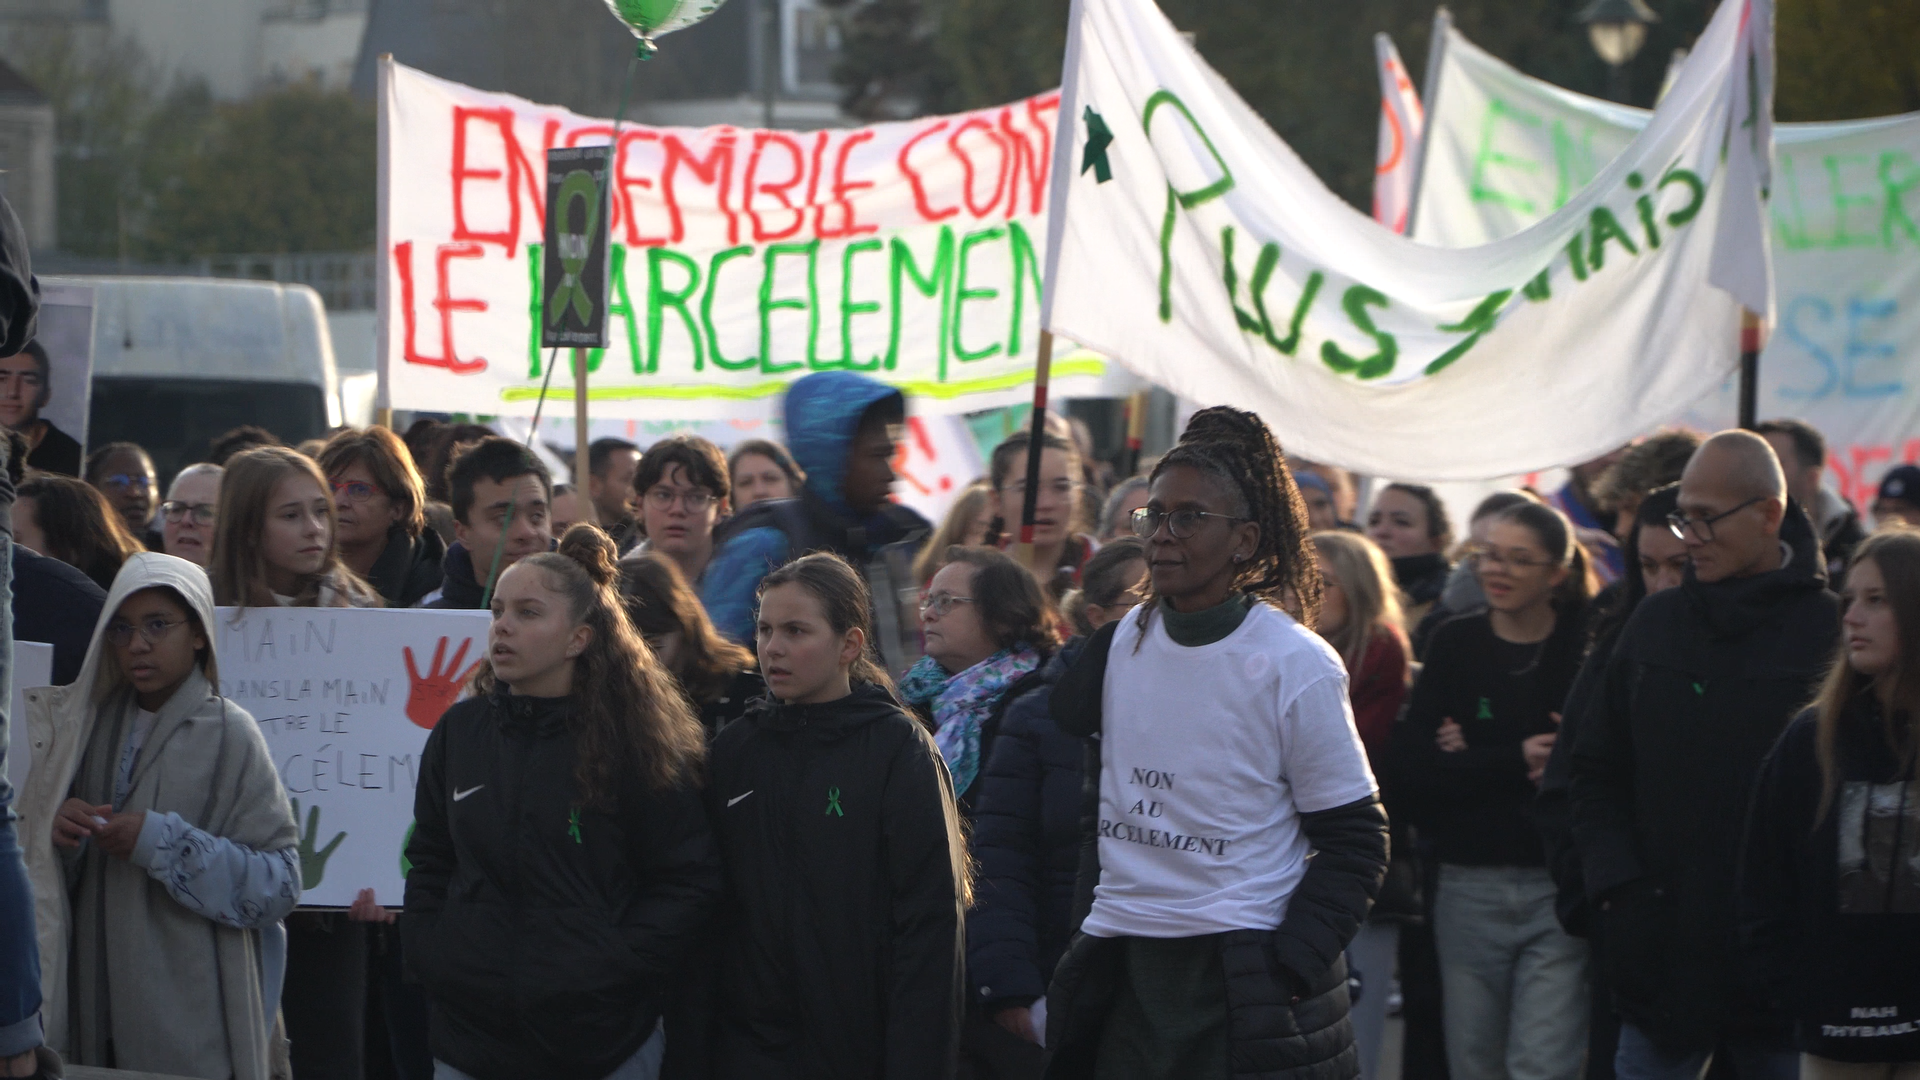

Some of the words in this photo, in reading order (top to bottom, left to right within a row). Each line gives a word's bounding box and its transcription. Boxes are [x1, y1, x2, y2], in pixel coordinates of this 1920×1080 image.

[1142, 88, 1399, 380] PLUS
[395, 241, 488, 373] LE
[319, 712, 351, 734] LE
[280, 743, 421, 793] CÉLEM
[1129, 767, 1175, 790] NON
[1128, 798, 1163, 818] AU
[1099, 820, 1230, 855] RCELEMENT
